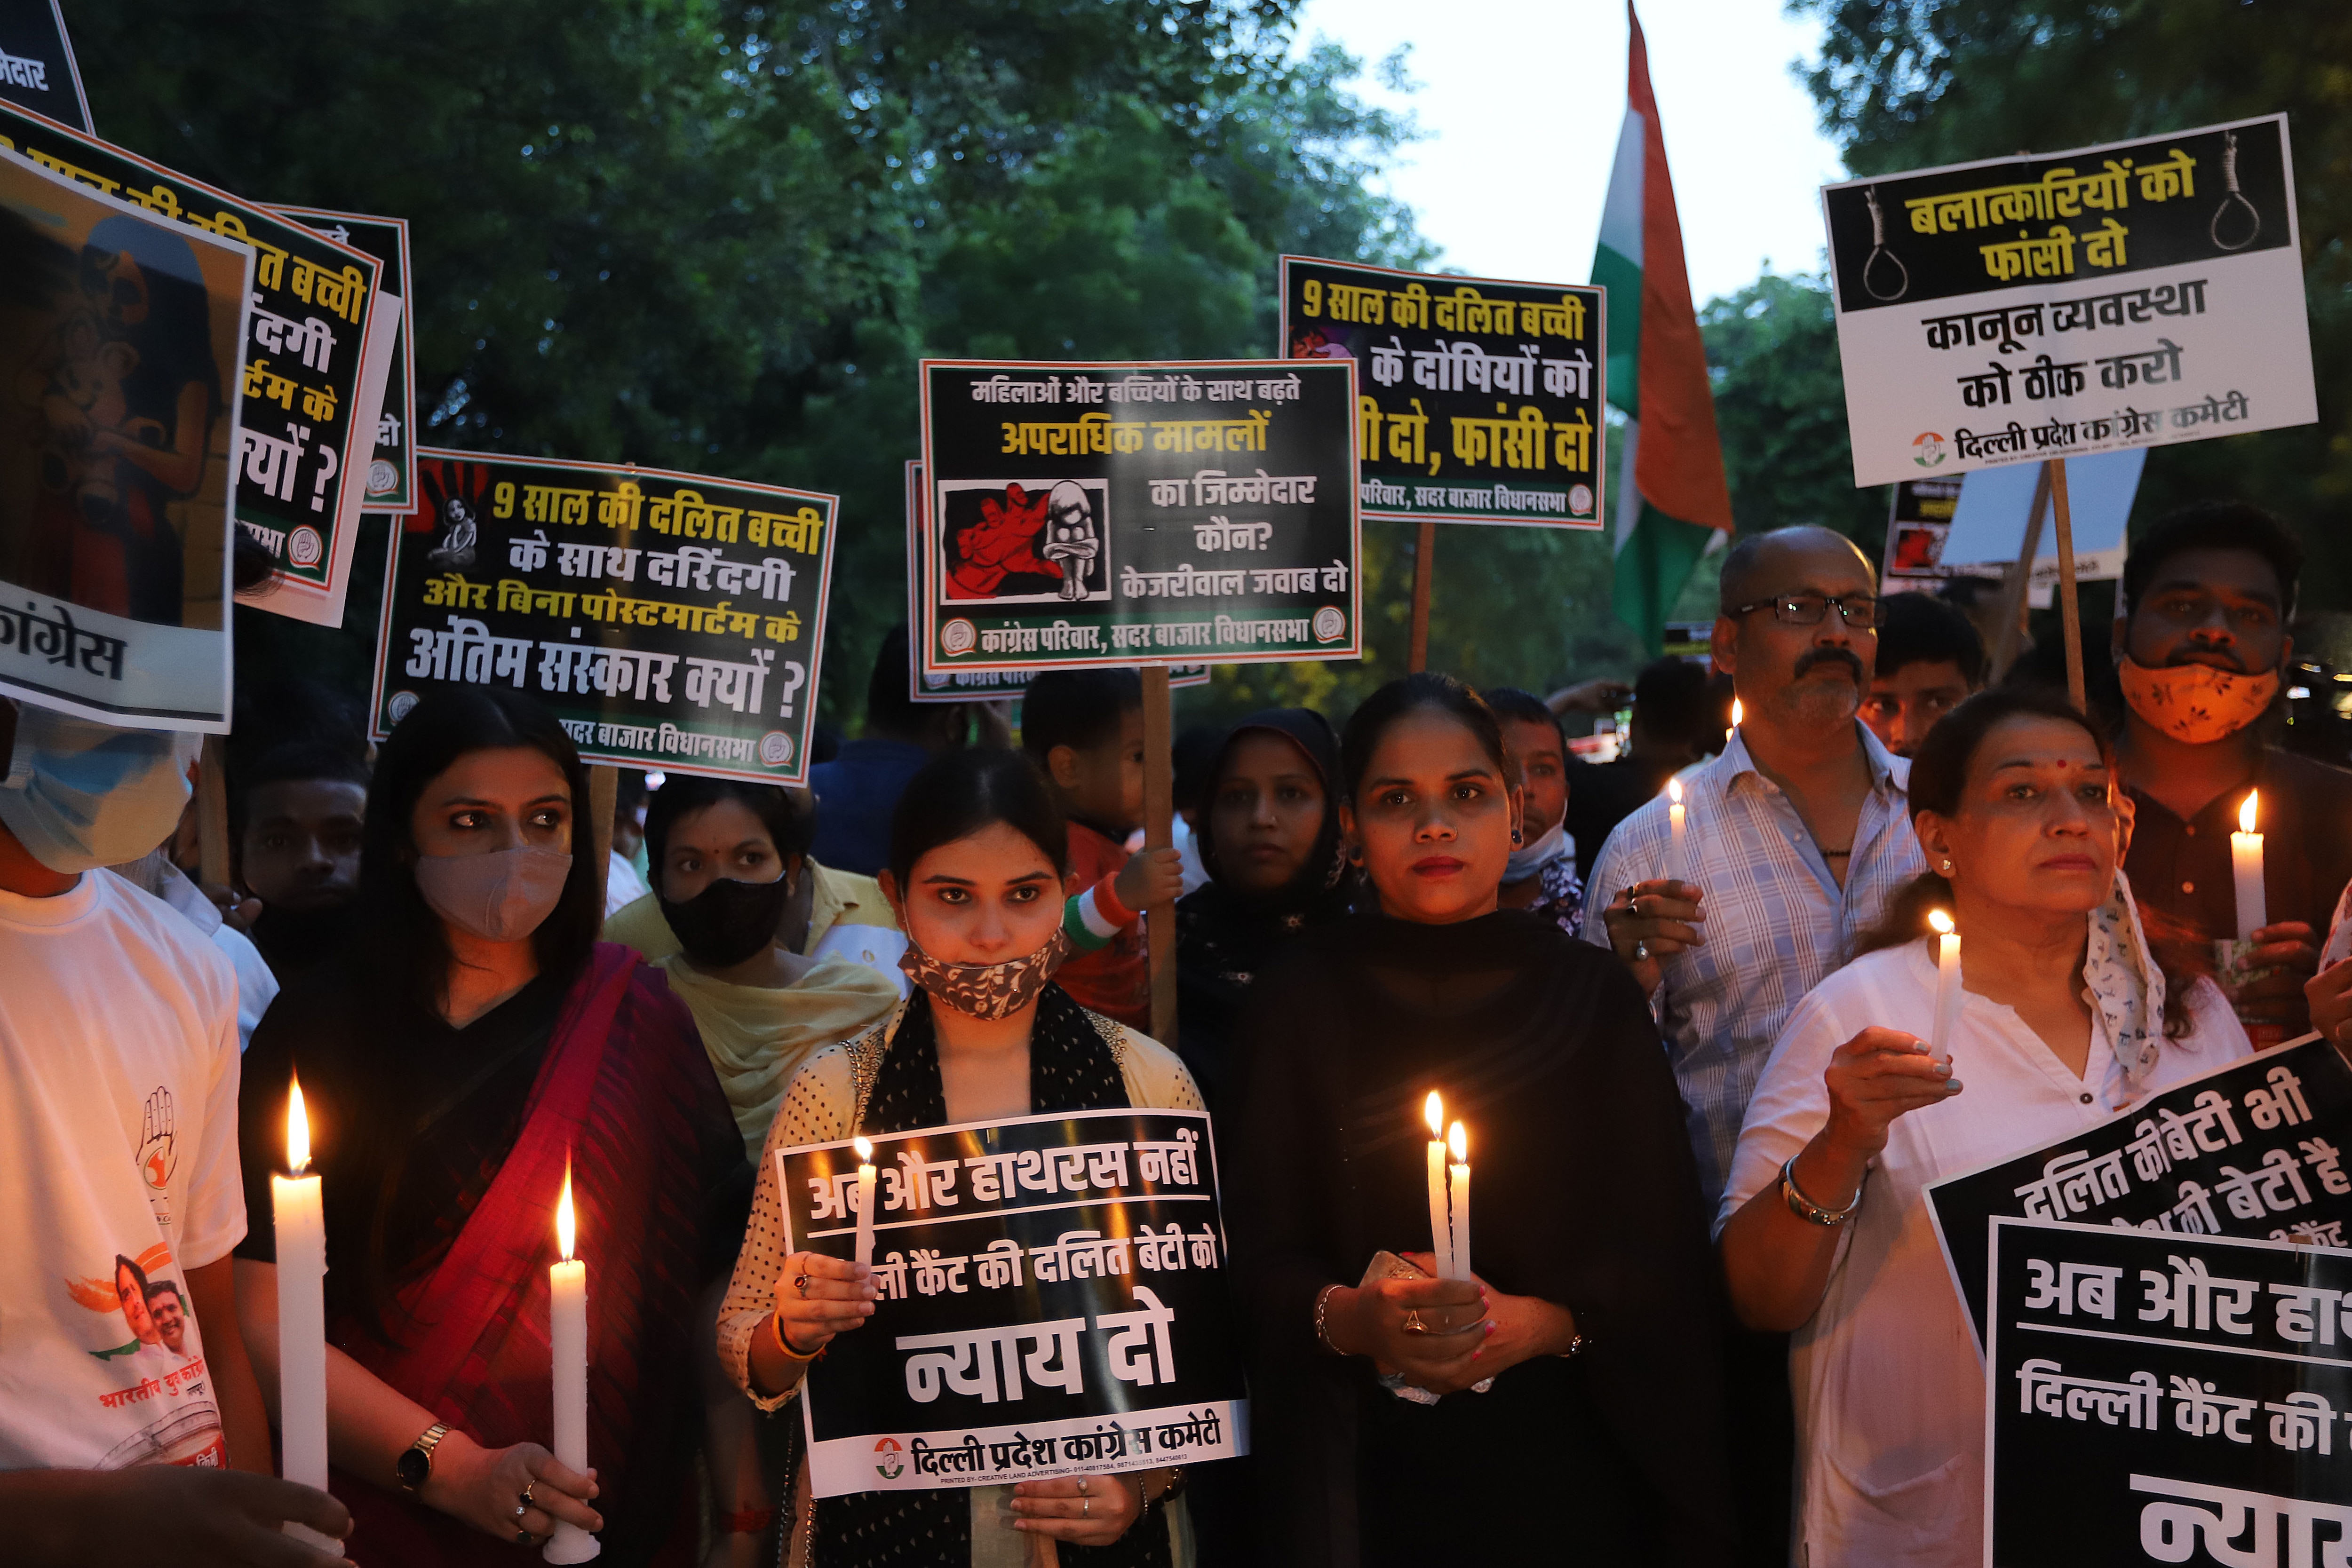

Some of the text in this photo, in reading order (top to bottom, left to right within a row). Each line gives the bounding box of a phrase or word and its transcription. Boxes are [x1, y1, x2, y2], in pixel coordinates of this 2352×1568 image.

[1905, 148, 2197, 236] बलात्कारियों को
[1979, 218, 2128, 282] फांसी दो
[292, 264, 367, 325] बच्ची
[1303, 279, 1586, 341] 9 साल की दलित बच्ची
[1921, 279, 2208, 355] कानून व्यवस्था
[970, 373, 1301, 407] महिलाओं और बच्चियों के साथ बढ़ते
[1370, 335, 1593, 400] के दोषियों को
[1957, 339, 2184, 409] को ठीक करो
[303, 384, 338, 423] के
[1001, 409, 1273, 455] अपराधिक मामलों
[1387, 398, 1441, 476] दो,
[1451, 402, 1549, 470] फांसी
[1553, 407, 1593, 473] दो
[1954, 421, 2027, 460] दिल्ली
[2031, 417, 2077, 450] प्रदेश
[2081, 407, 2164, 444] कांग्रेस
[2168, 390, 2250, 430] कमेटी
[311, 444, 337, 513] ?
[1149, 469, 1317, 508] का जिम्मेदार
[1414, 486, 1446, 507] सदर
[1448, 487, 1493, 509] बाजार
[1494, 483, 1566, 514] विधानसभा
[493, 481, 824, 555] 9 साल की दलित बच्ची
[1193, 516, 1273, 552] कौन?
[508, 530, 796, 602] के साथ दरिंदगी
[1120, 559, 1348, 600] केजरीवाल जवाब दो
[422, 573, 802, 644] और बिना पोस्टमार्टम के
[981, 616, 1310, 655] कांग्रेस परिवार, सदर बाजार विधानसभा
[405, 615, 806, 719] अंतिम संस्कार क्यों ?
[597, 722, 657, 752] बाजार
[658, 722, 756, 763] विधानसभा
[881, 1150, 960, 1212] और
[964, 1141, 1129, 1202] हाथरस
[1132, 1127, 1200, 1188] नहीं
[2014, 1066, 2313, 1221] दलित की बेटी भी
[2214, 1148, 2312, 1219] बेटी
[2298, 1137, 2352, 1195] है
[909, 1248, 971, 1297] कैंट
[974, 1238, 1024, 1290] की
[1029, 1230, 1130, 1283] दलित
[1133, 1222, 1187, 1272] बेटी
[1188, 1224, 1219, 1269] को
[2025, 1259, 2123, 1320] अब
[2138, 1256, 2260, 1336] और
[895, 1284, 1175, 1405] न्याय दो
[911, 1407, 1222, 1476] दिल्ली प्रदेश कांग्रेस कमेटी
[2016, 1359, 2164, 1431] दिल्ली
[2170, 1376, 2258, 1444] कैंट
[2264, 1391, 2337, 1455] की
